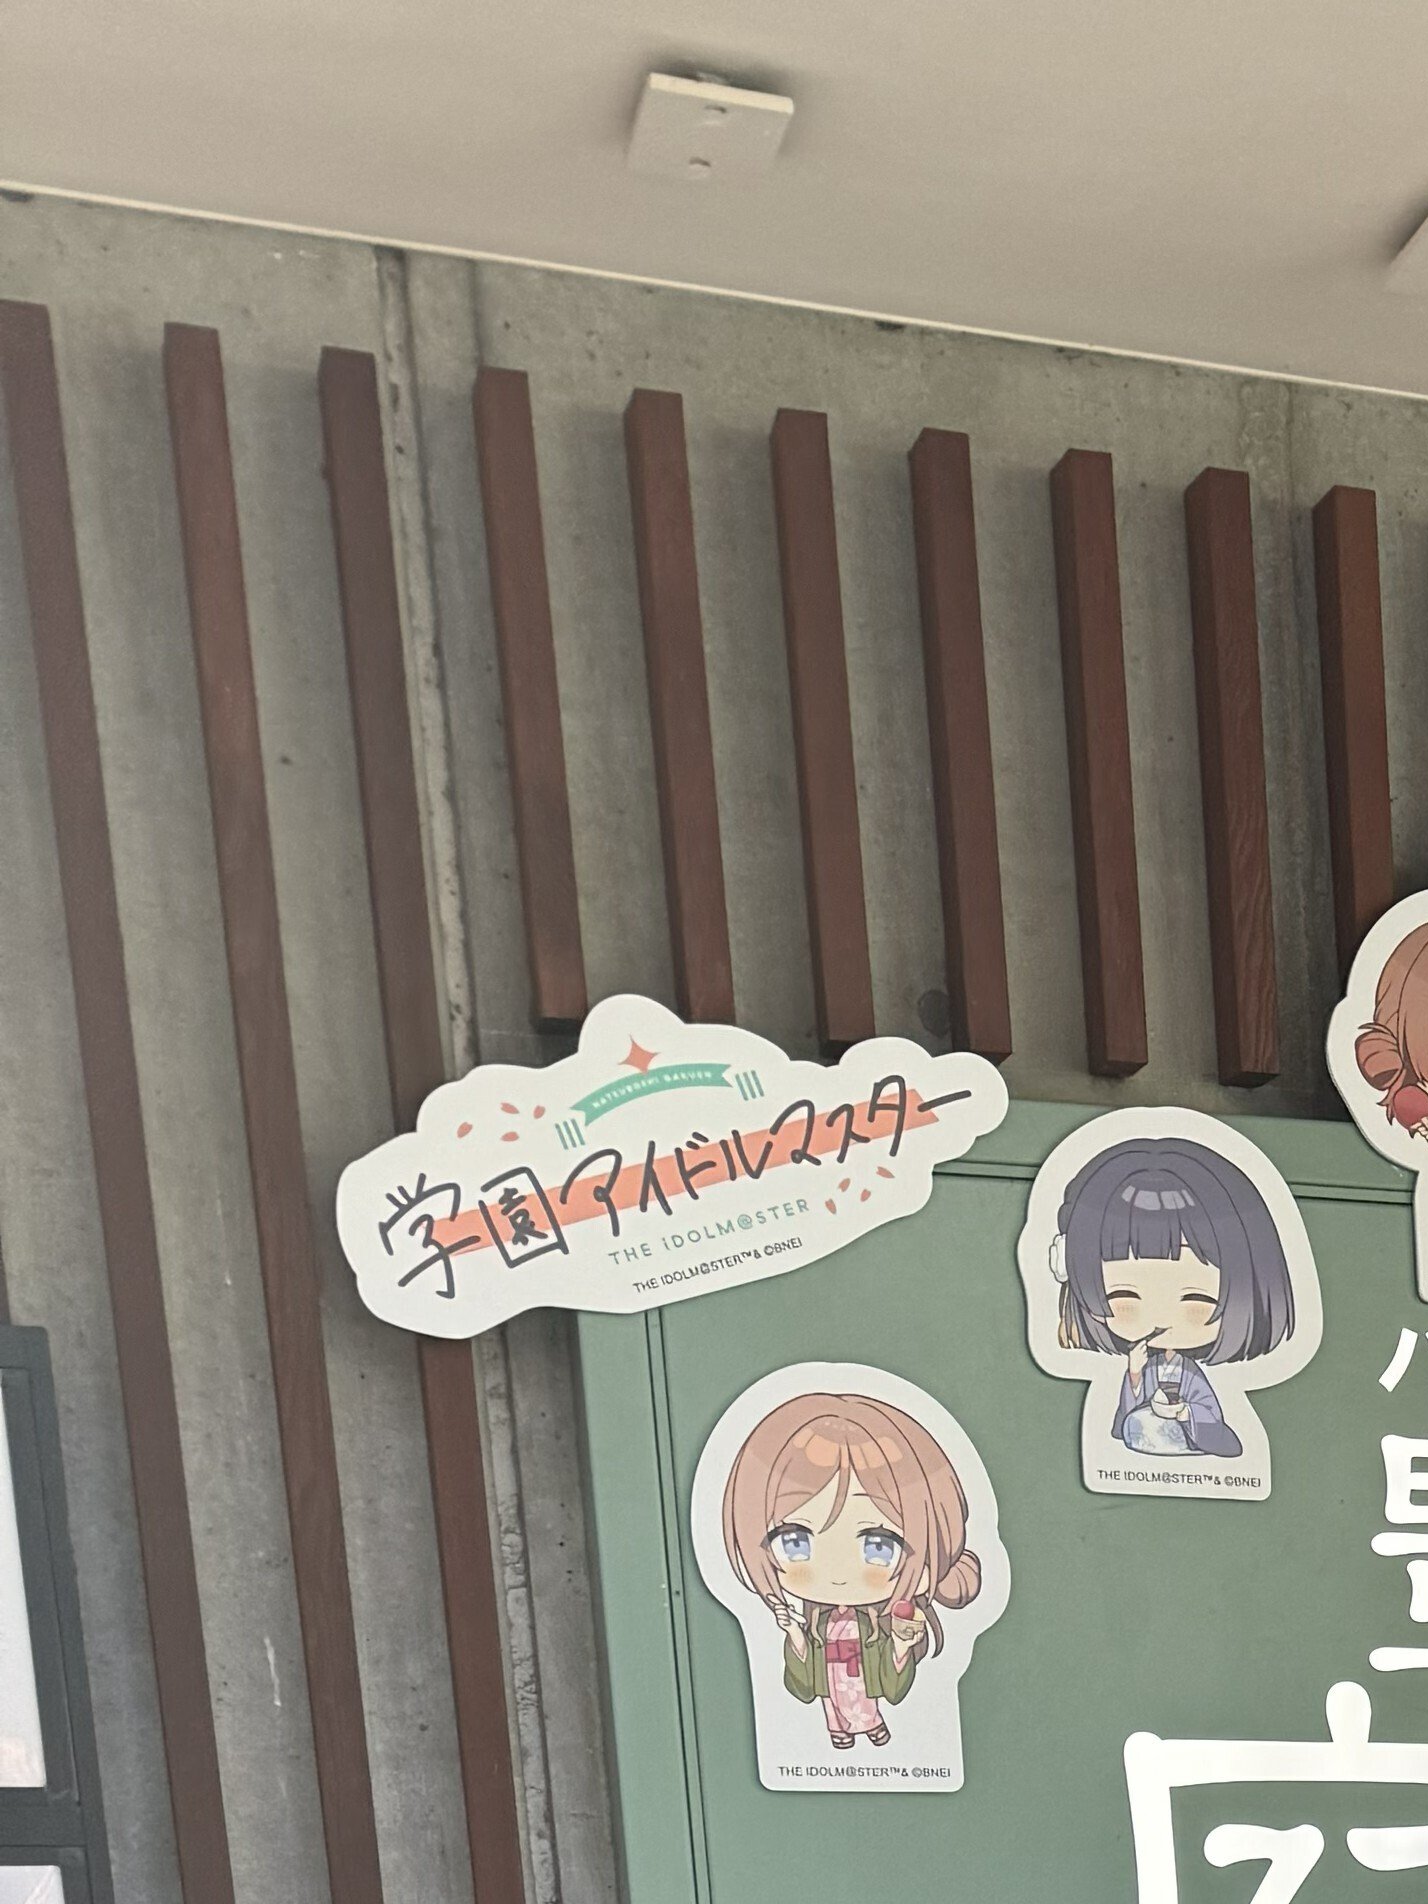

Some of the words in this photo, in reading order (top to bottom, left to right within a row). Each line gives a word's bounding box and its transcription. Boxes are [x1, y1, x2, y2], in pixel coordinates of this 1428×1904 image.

[378, 1073, 972, 1300] 学園アイドルマスター
[608, 1242, 653, 1265] THE
[632, 1277, 659, 1294] THE
[778, 1766, 802, 1777] THE
